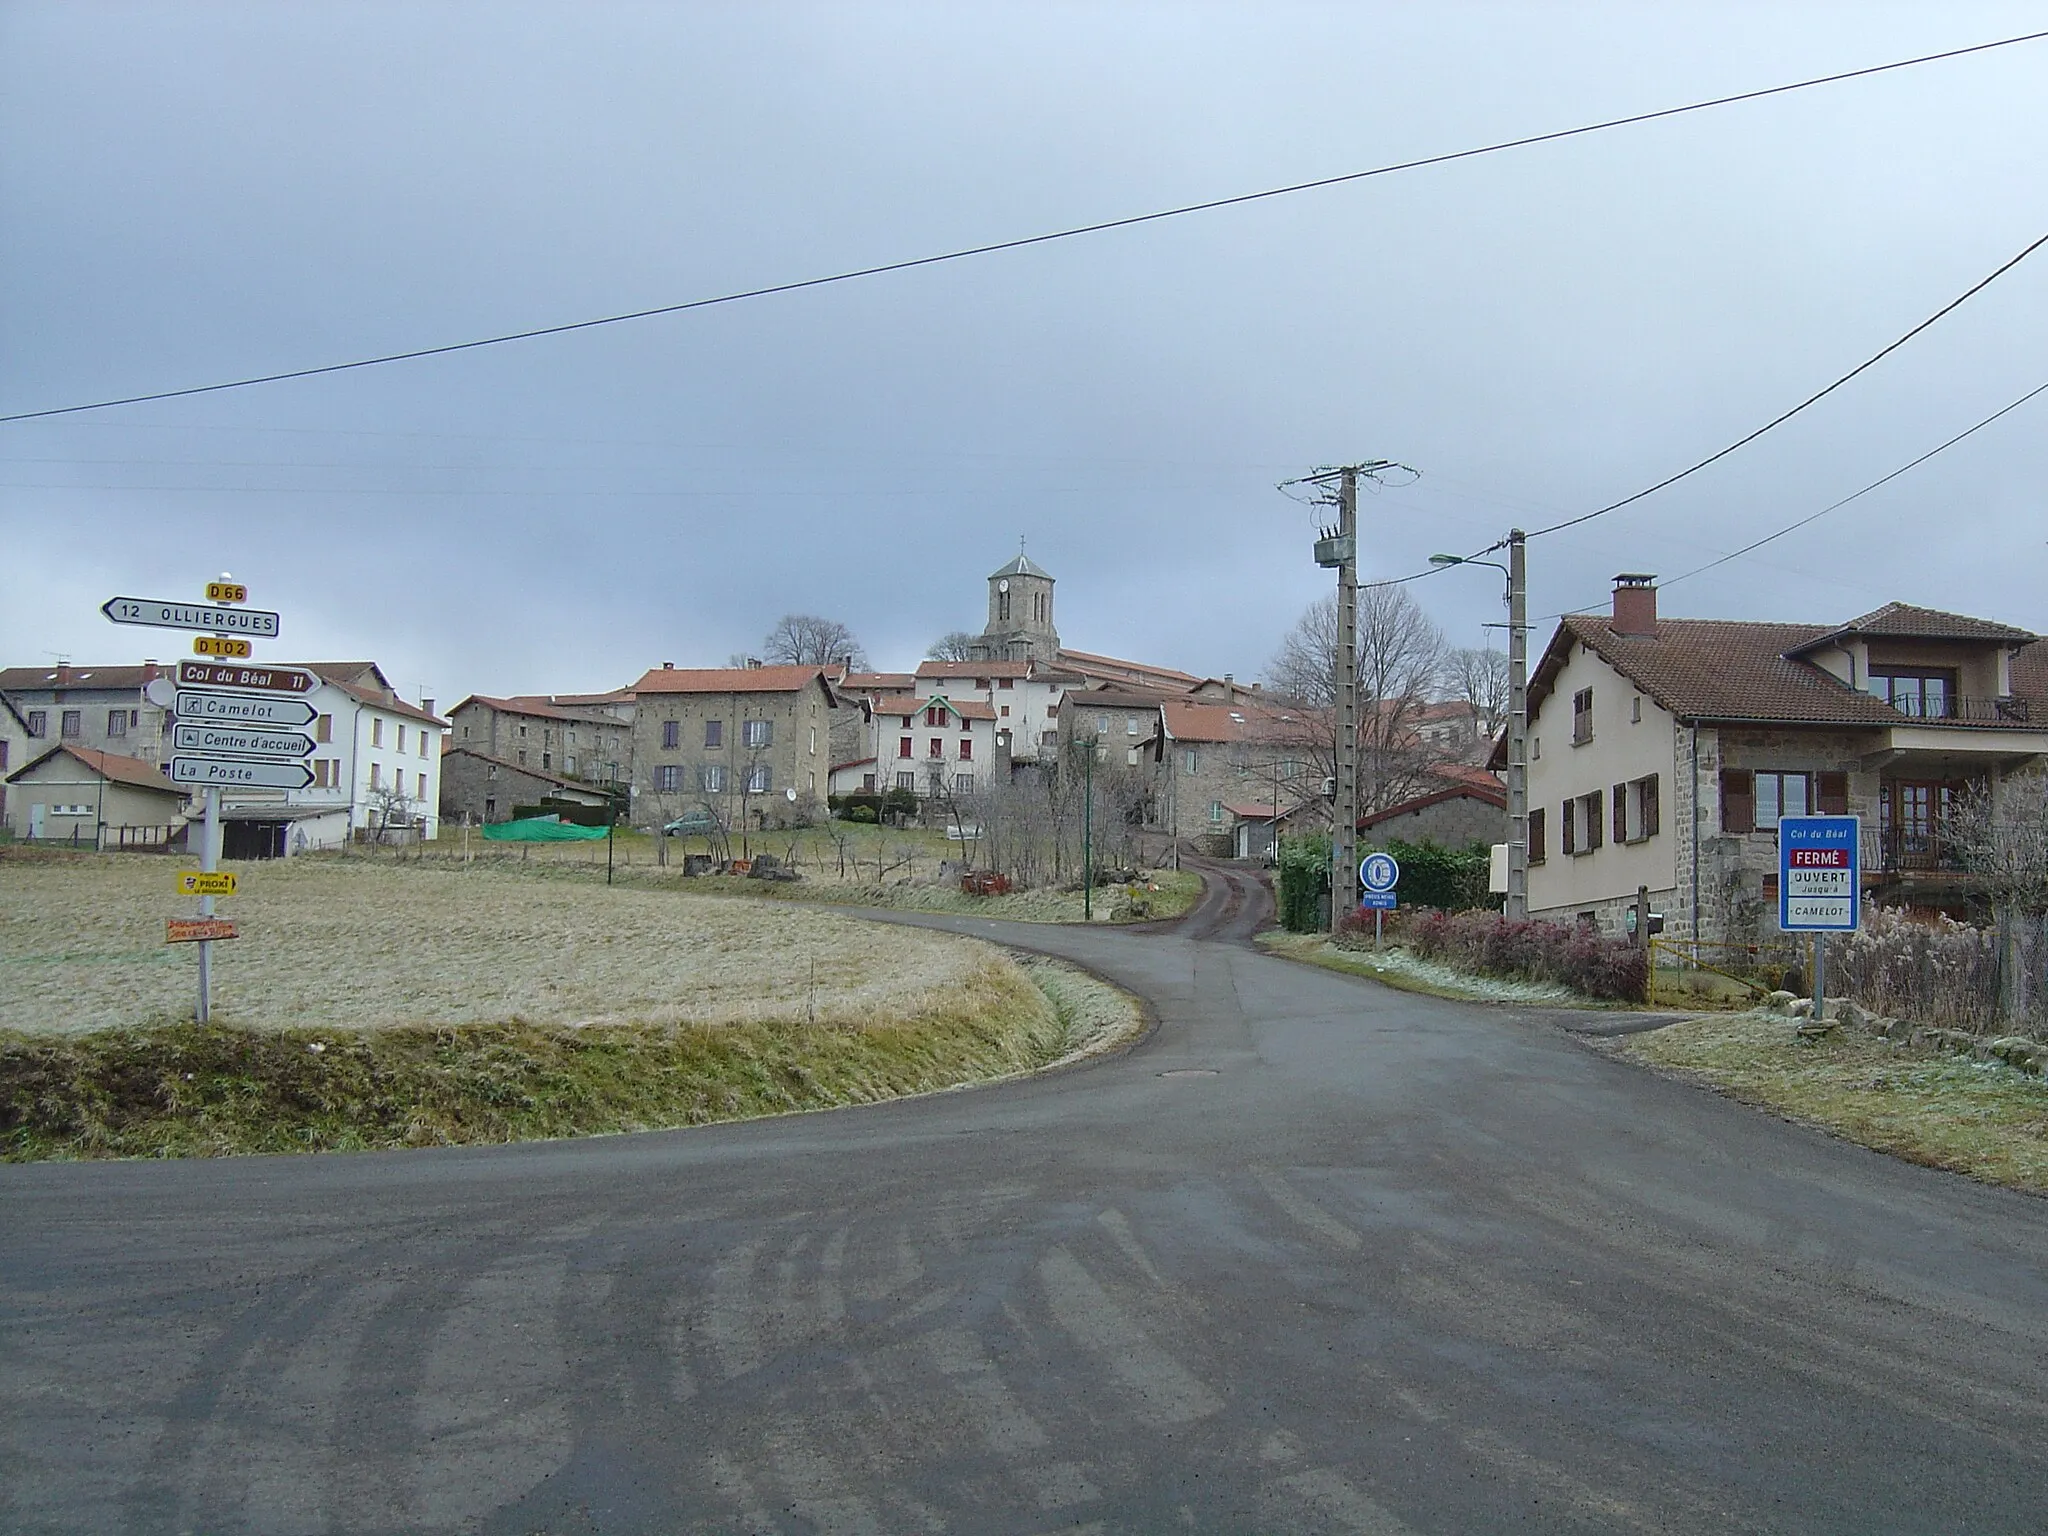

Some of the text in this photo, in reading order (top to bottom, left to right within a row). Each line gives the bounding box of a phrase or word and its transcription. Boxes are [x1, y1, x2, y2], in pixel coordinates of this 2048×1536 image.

[210, 586, 244, 599] D 66
[122, 604, 273, 629] 12 OLLIERGUES
[199, 641, 246, 656] D 102
[186, 666, 305, 689] Col du Béal 11
[206, 700, 273, 718] Camelot
[204, 732, 306, 753] Centre d'accueil
[180, 763, 253, 781] La Poste
[1790, 829, 1847, 839] Col du Béal
[1796, 850, 1840, 865] FERMÉ
[199, 880, 228, 888] PROXI
[1795, 872, 1846, 883] OUVERT
[1795, 907, 1844, 916] CAMELOT
